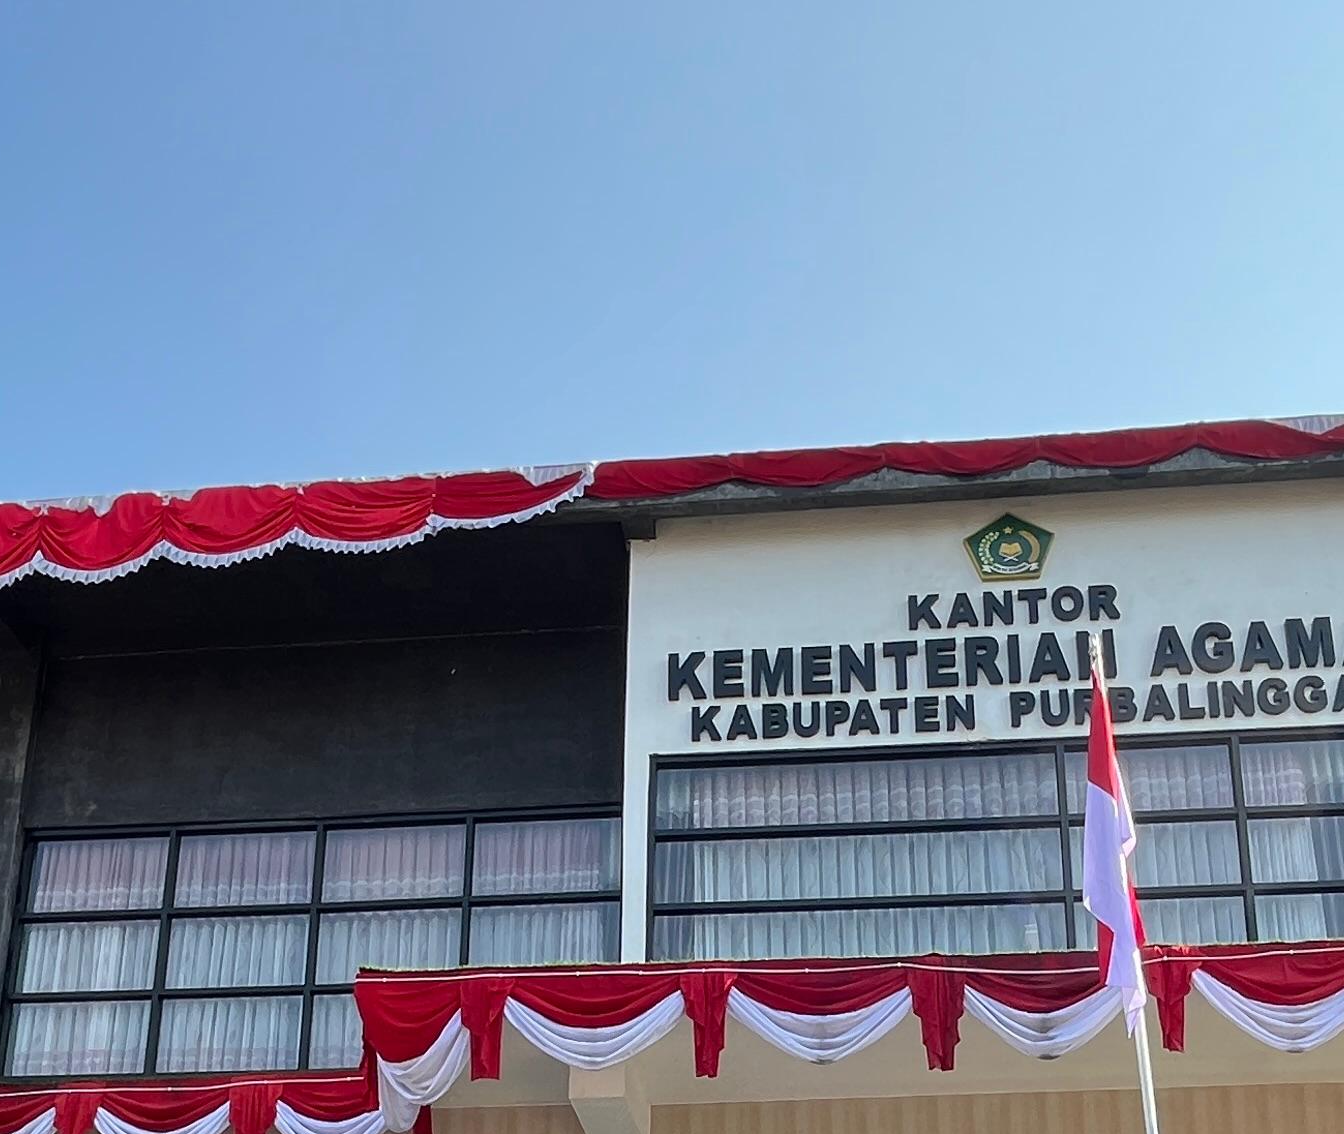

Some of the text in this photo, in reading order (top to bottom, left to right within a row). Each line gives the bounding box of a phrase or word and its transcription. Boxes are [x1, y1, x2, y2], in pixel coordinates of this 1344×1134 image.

[908, 584, 1121, 631] KANTOR
[667, 631, 1117, 702] KEMENTERIAN
[691, 694, 976, 743] KABUPATEN
